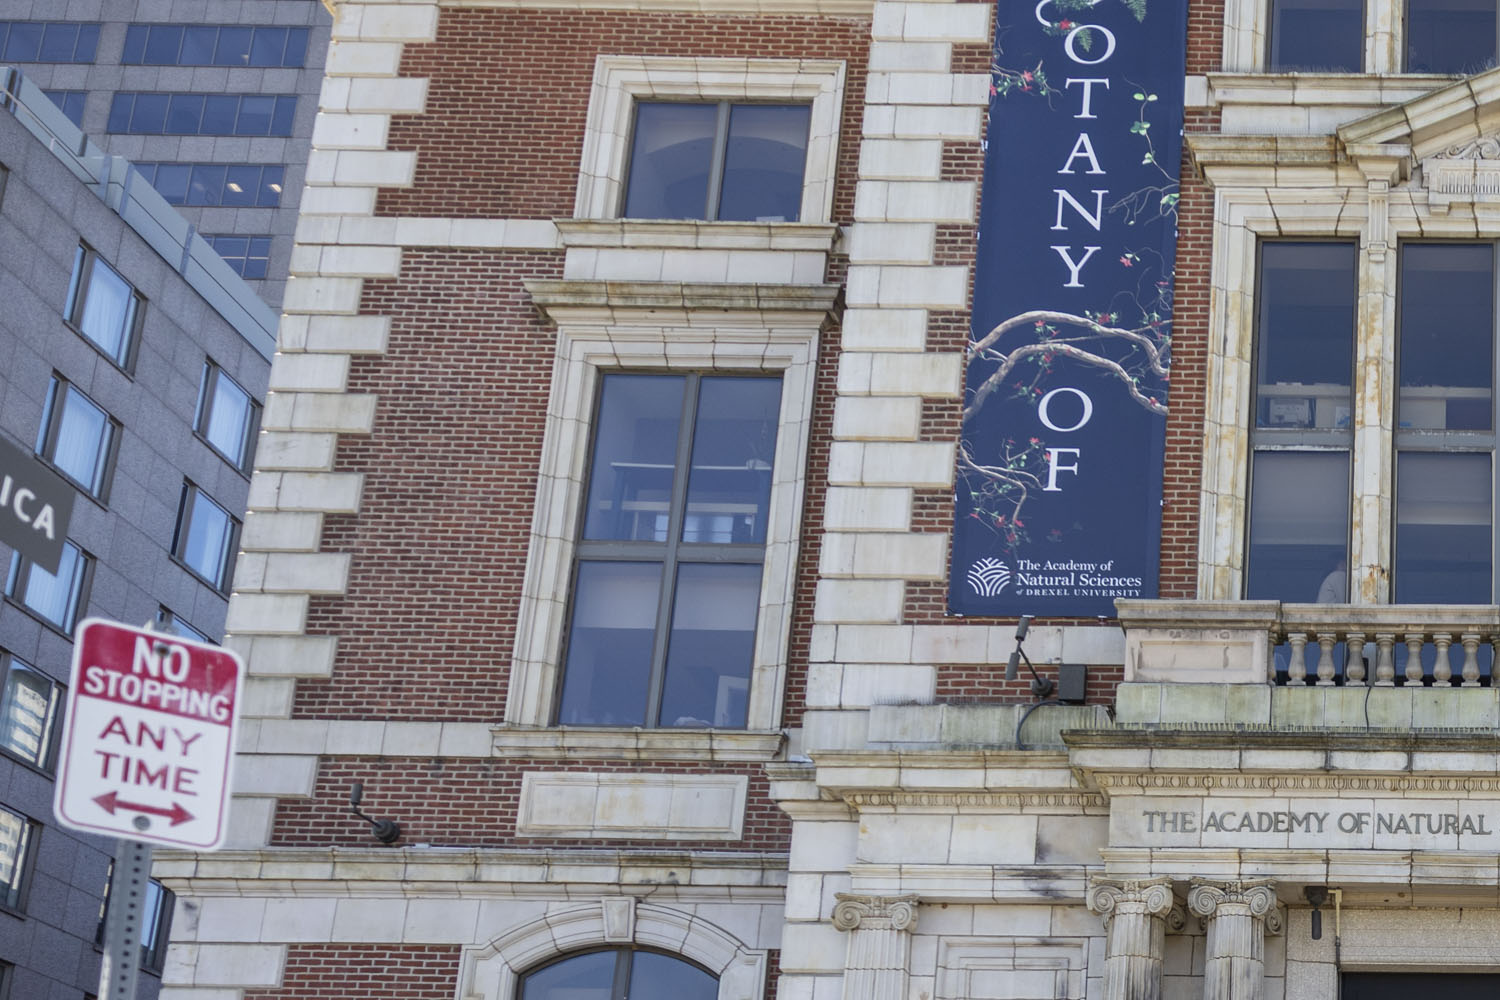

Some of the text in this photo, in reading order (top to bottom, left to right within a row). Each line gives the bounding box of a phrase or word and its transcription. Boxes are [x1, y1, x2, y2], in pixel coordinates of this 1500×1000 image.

[1038, 387, 1093, 492] OF
[0, 474, 56, 540] ICA
[1016, 573, 1142, 587] Natural Sciences
[1017, 559, 1114, 573] The Academy of
[1074, 589, 1141, 597] UNIVERSITY
[132, 636, 191, 684] NO
[84, 667, 230, 721] STOPPING
[99, 715, 204, 757] ANY
[95, 750, 200, 796] TIME
[1143, 810, 1197, 833] THE
[1203, 811, 1330, 834] ACADEMY
[1337, 812, 1372, 834] OF
[1376, 813, 1492, 836] NATURAL
